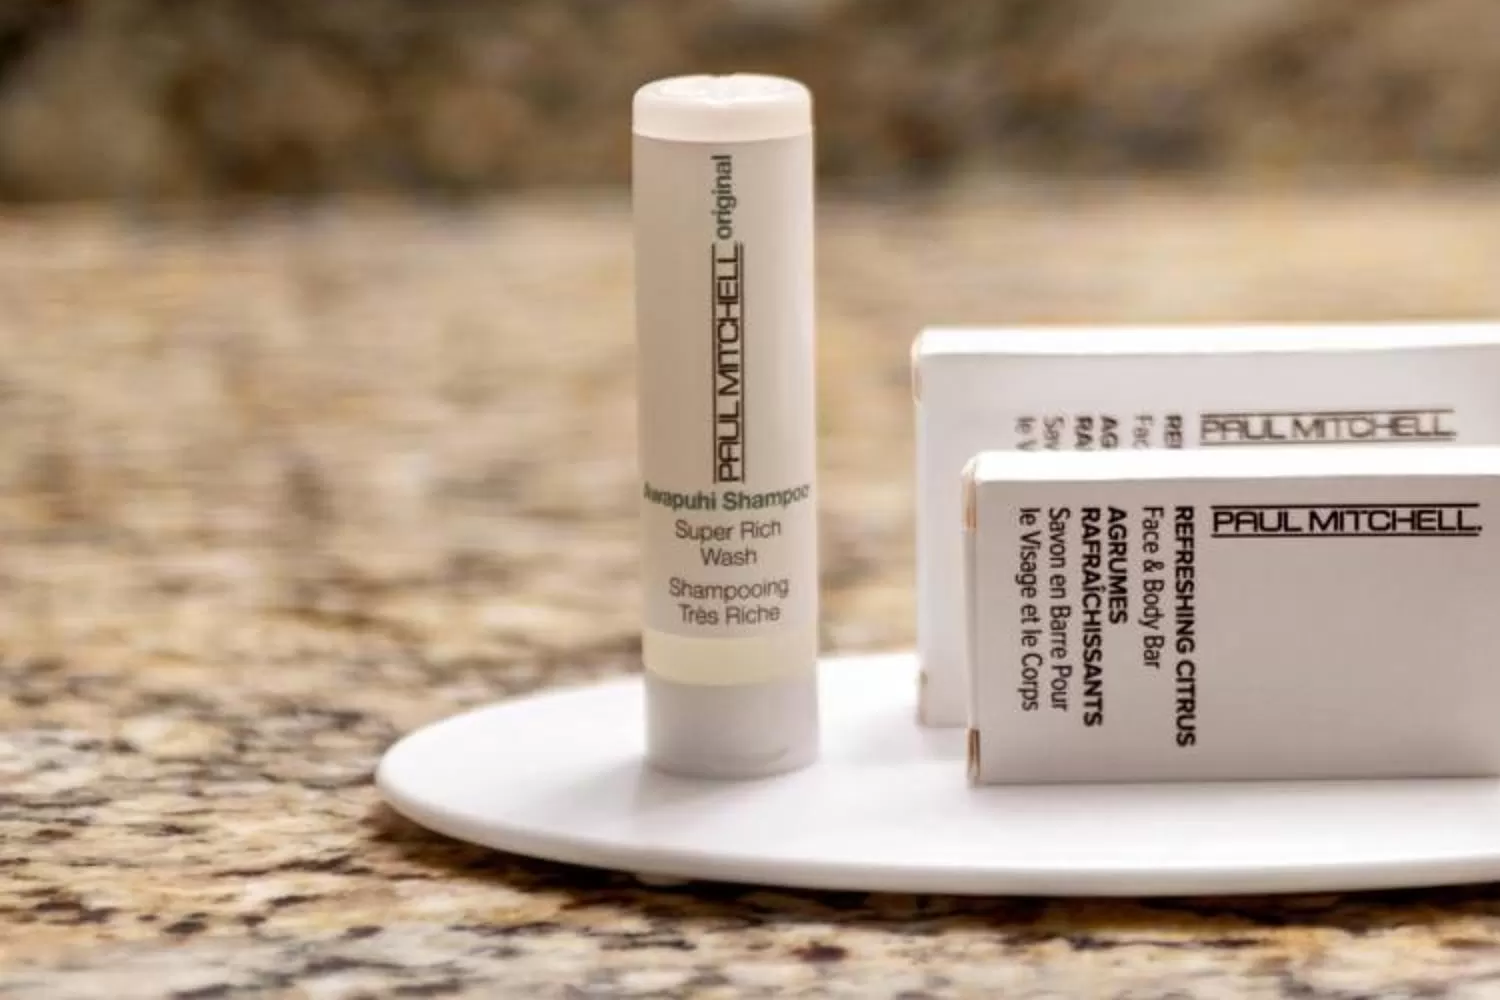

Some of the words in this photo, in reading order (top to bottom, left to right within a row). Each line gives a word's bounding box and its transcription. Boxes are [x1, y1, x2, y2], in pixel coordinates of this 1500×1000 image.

[710, 154, 737, 240] original
[716, 242, 740, 396] MITCHELL
[718, 401, 741, 482] PAUL
[1201, 418, 1286, 441] PAUL
[674, 519, 733, 543] Super
[740, 520, 781, 540] Rich
[1019, 508, 1041, 526] le
[1049, 507, 1071, 569] Savon
[1142, 506, 1165, 554] Face
[1213, 511, 1302, 533] PAUL
[700, 545, 757, 567] Wash
[1015, 530, 1041, 599] Visage
[1107, 506, 1128, 625] AGRUMES
[1143, 559, 1164, 573] &
[1175, 505, 1195, 654] REFRESHING
[668, 577, 790, 603] Shampooing
[1050, 574, 1066, 599] en
[1138, 579, 1165, 630] Body
[677, 603, 719, 625] Très
[725, 604, 781, 626] Riche
[1020, 604, 1041, 624] et
[1050, 605, 1071, 660] Barre
[1081, 507, 1106, 727] RAFRAÎCHISSANTS
[1021, 629, 1043, 648] le
[1143, 635, 1165, 669] Bar
[1017, 653, 1043, 712] Corps
[1051, 665, 1073, 712] Pour
[1175, 660, 1196, 747] CITRUS
